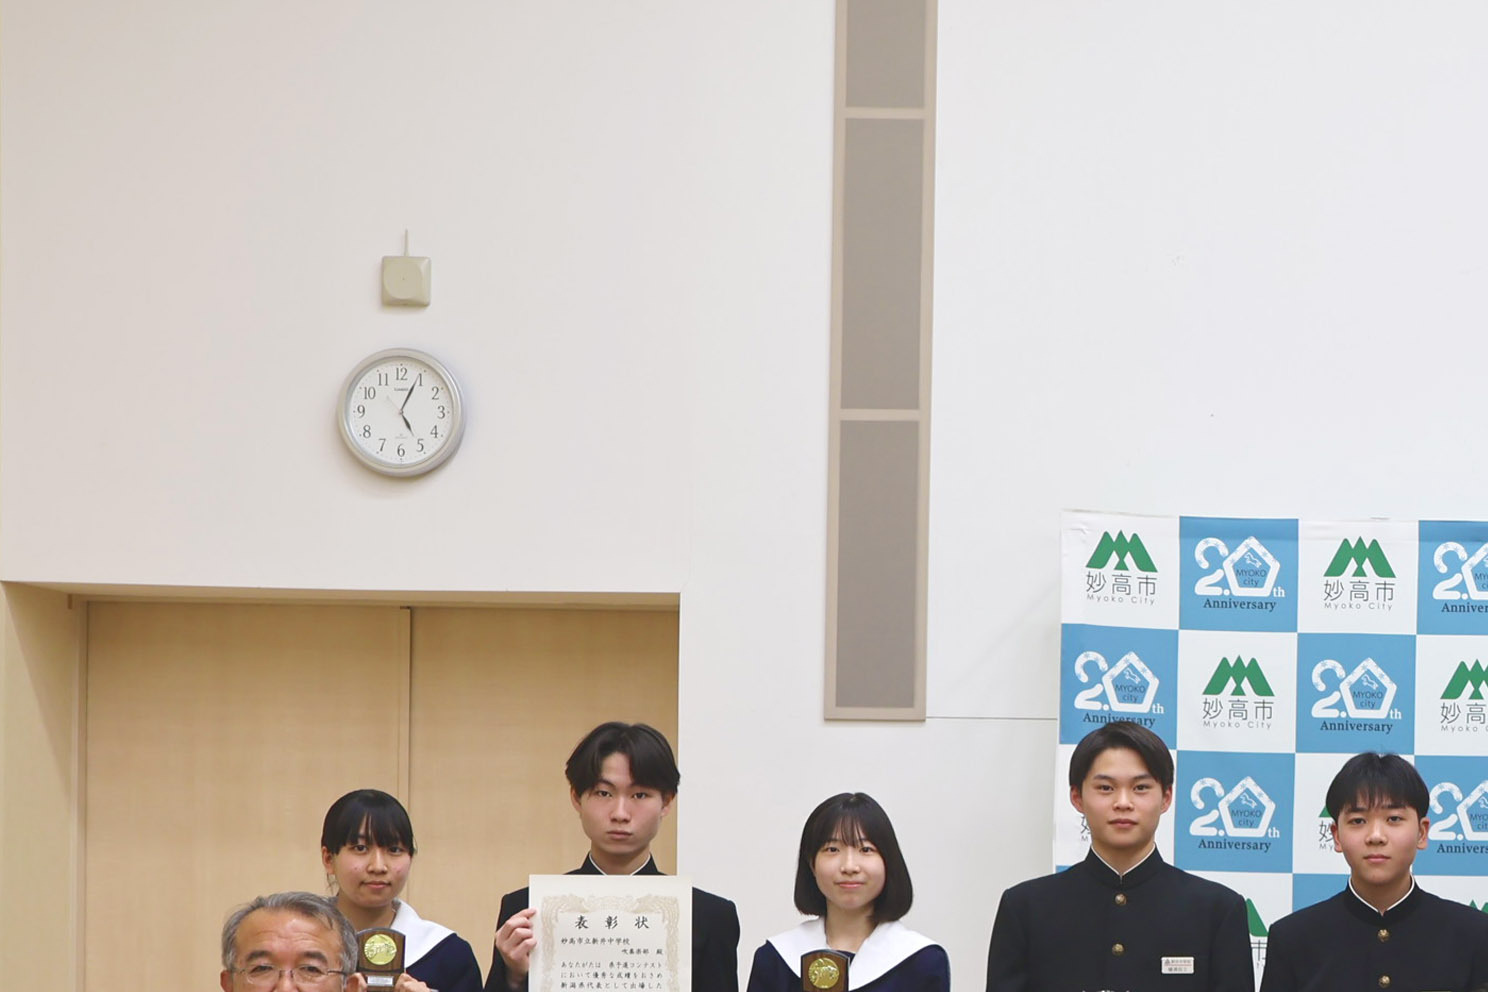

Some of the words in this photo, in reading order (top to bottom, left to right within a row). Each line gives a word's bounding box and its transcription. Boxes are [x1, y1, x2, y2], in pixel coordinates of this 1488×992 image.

[378, 373, 388, 386] 11
[396, 367, 408, 381] 12
[417, 373, 424, 386] 1
[363, 387, 376, 399] 10
[432, 387, 439, 400] 2
[357, 405, 365, 417] 9
[437, 405, 445, 418] 3
[363, 425, 371, 438] 8
[430, 425, 438, 438] 4
[378, 439, 386, 451] 7
[397, 444, 405, 457] 6
[417, 439, 424, 451] 5
[1236, 569, 1266, 578] MYOKO
[1085, 571, 1157, 596] 妙高市
[1243, 578, 1259, 588] city
[1323, 579, 1394, 602] 妙高市
[1087, 595, 1123, 604] Myoko
[1129, 596, 1155, 606] City
[1203, 598, 1277, 612] Anniversary
[1324, 602, 1361, 611] Myoko
[1367, 602, 1393, 611] City
[1115, 685, 1145, 694] MYOKO
[1353, 690, 1383, 699] MYOKO
[1123, 693, 1139, 704] city
[1360, 699, 1376, 709] city
[1202, 698, 1274, 721] 妙高市
[1203, 720, 1239, 729] Myoko
[1247, 720, 1272, 730] City
[1320, 720, 1393, 734] Anniversary
[1441, 724, 1478, 733] Myoko
[1231, 809, 1262, 818] MYOKO
[1238, 818, 1254, 829] city
[1198, 838, 1271, 852] Anniversary
[574, 914, 650, 930] 表彰状
